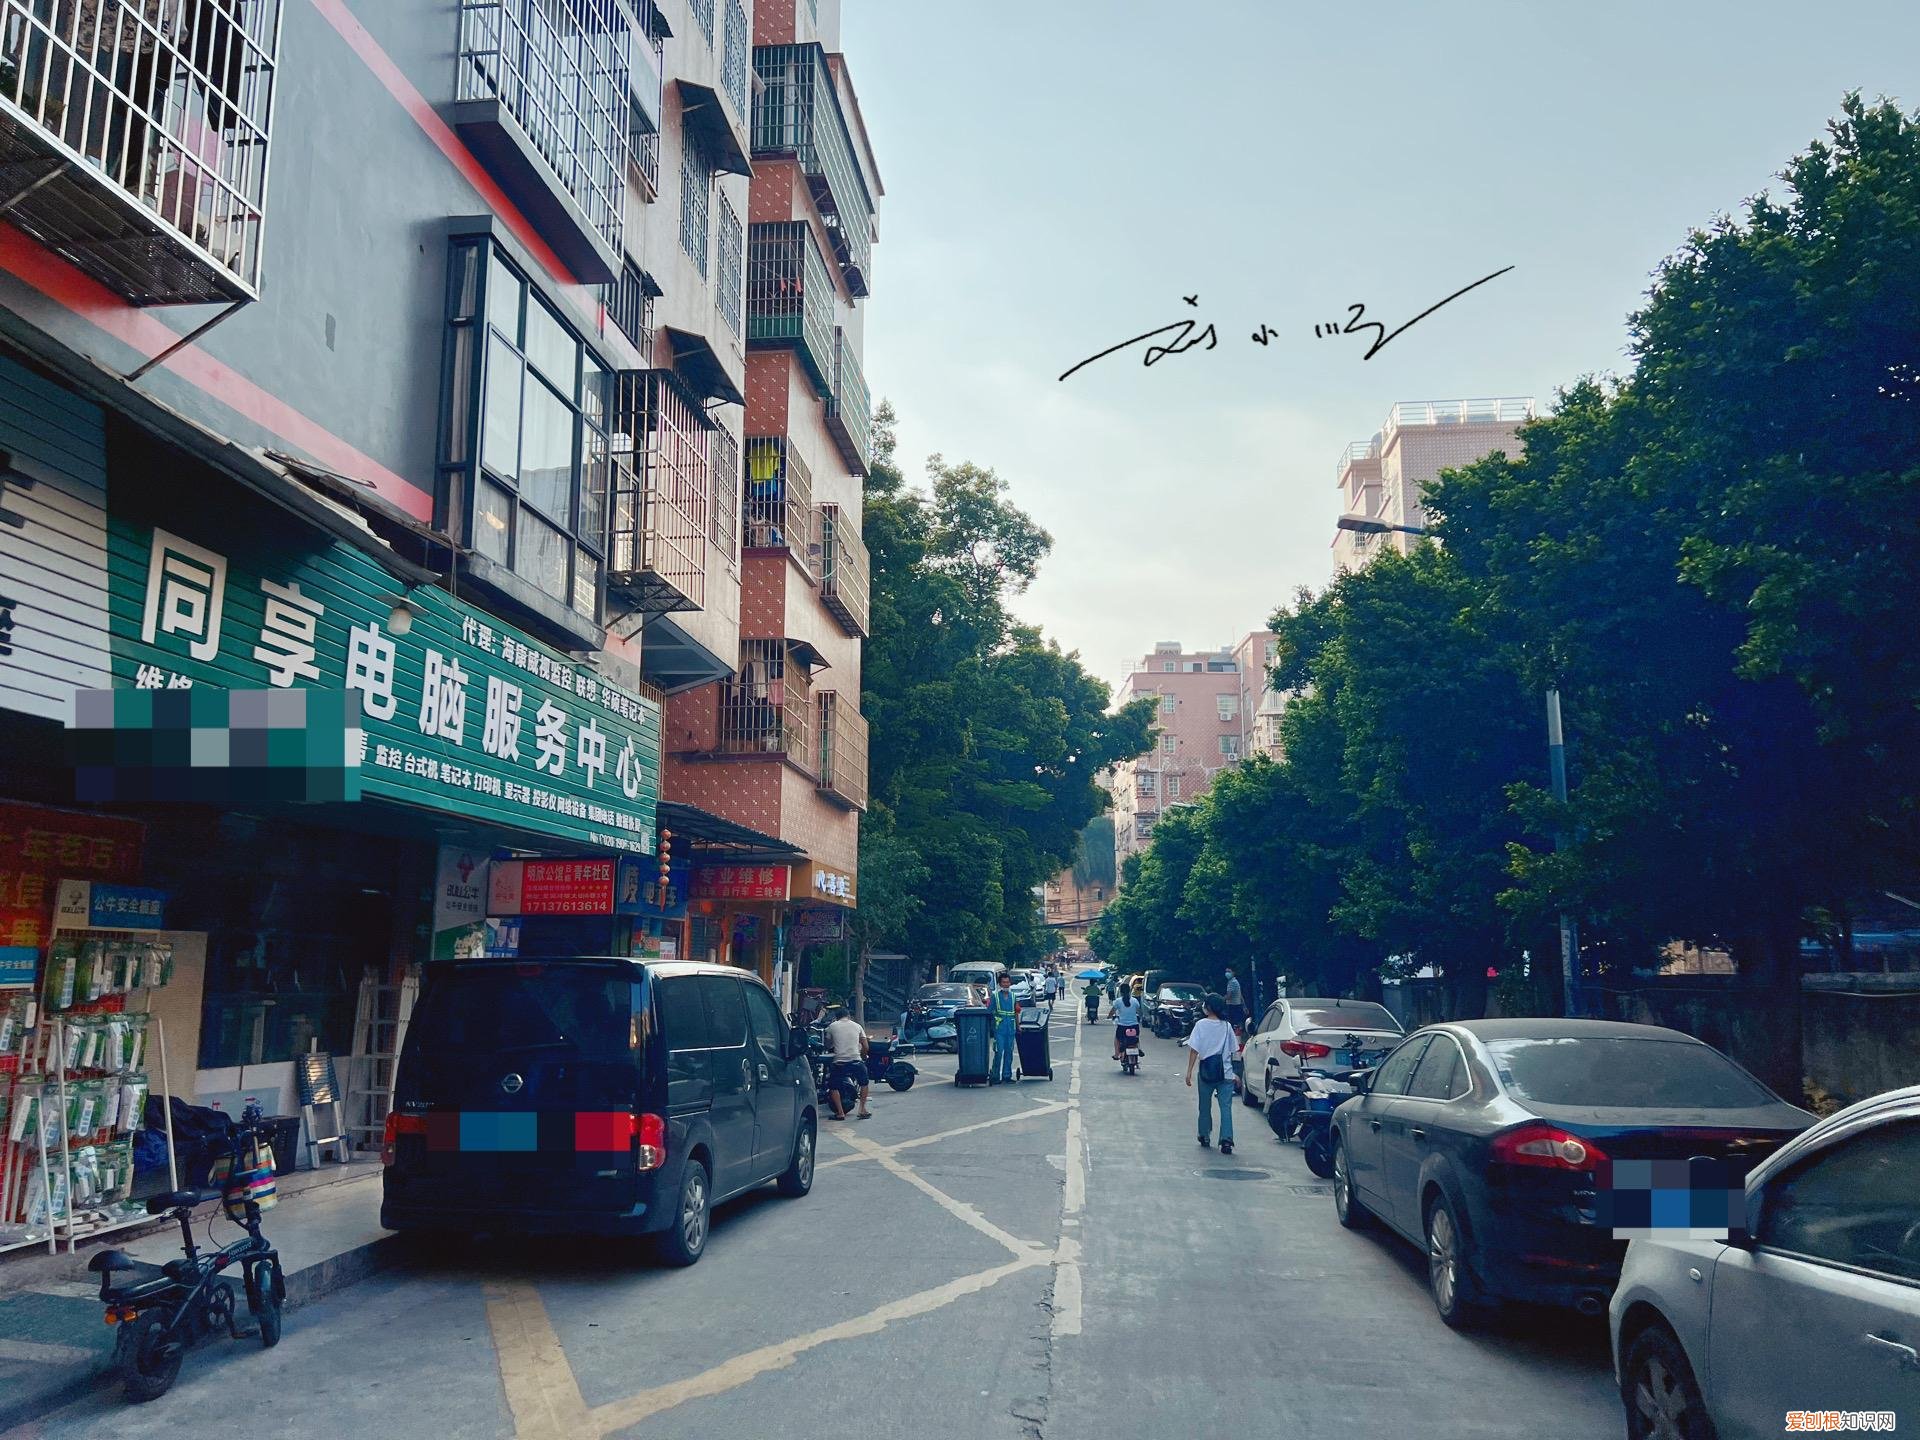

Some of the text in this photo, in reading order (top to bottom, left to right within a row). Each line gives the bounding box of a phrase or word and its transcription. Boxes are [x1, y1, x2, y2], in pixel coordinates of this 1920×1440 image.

[141, 526, 642, 799] 同享电脑服务中心
[502, 634, 571, 692] 海康威视监控
[576, 674, 597, 702] 联想
[375, 744, 402, 770] 监控
[404, 752, 439, 780] 台式机
[440, 762, 472, 788] 笔记本
[474, 771, 502, 797] 打印机
[503, 781, 531, 805] 显示器
[701, 867, 774, 885] 专业维修
[755, 886, 782, 898] 三轮车
